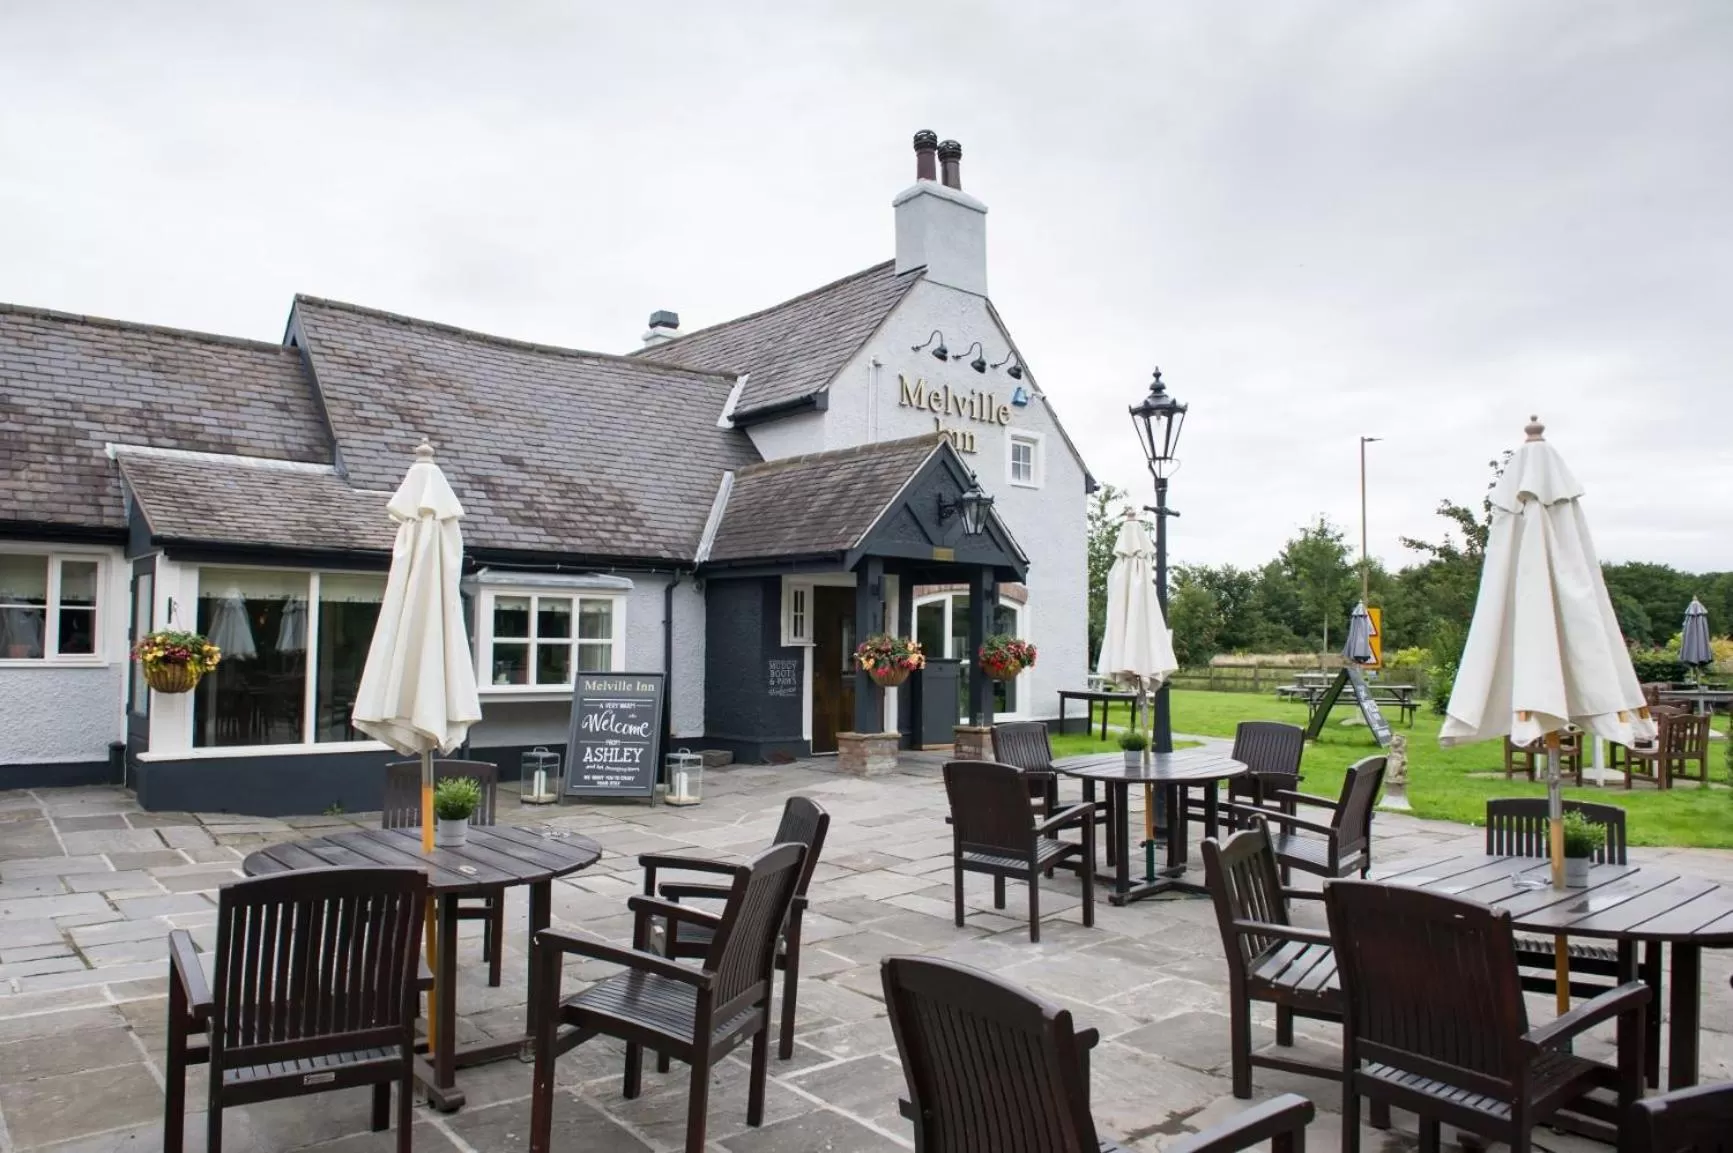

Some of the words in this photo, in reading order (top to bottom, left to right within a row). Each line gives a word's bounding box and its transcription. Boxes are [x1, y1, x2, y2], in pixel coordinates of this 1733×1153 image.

[898, 374, 1012, 426] Melville
[584, 680, 633, 692] Melville
[636, 681, 656, 692] Inn
[581, 709, 653, 738] Welcome
[582, 747, 644, 762] ASHLEY
